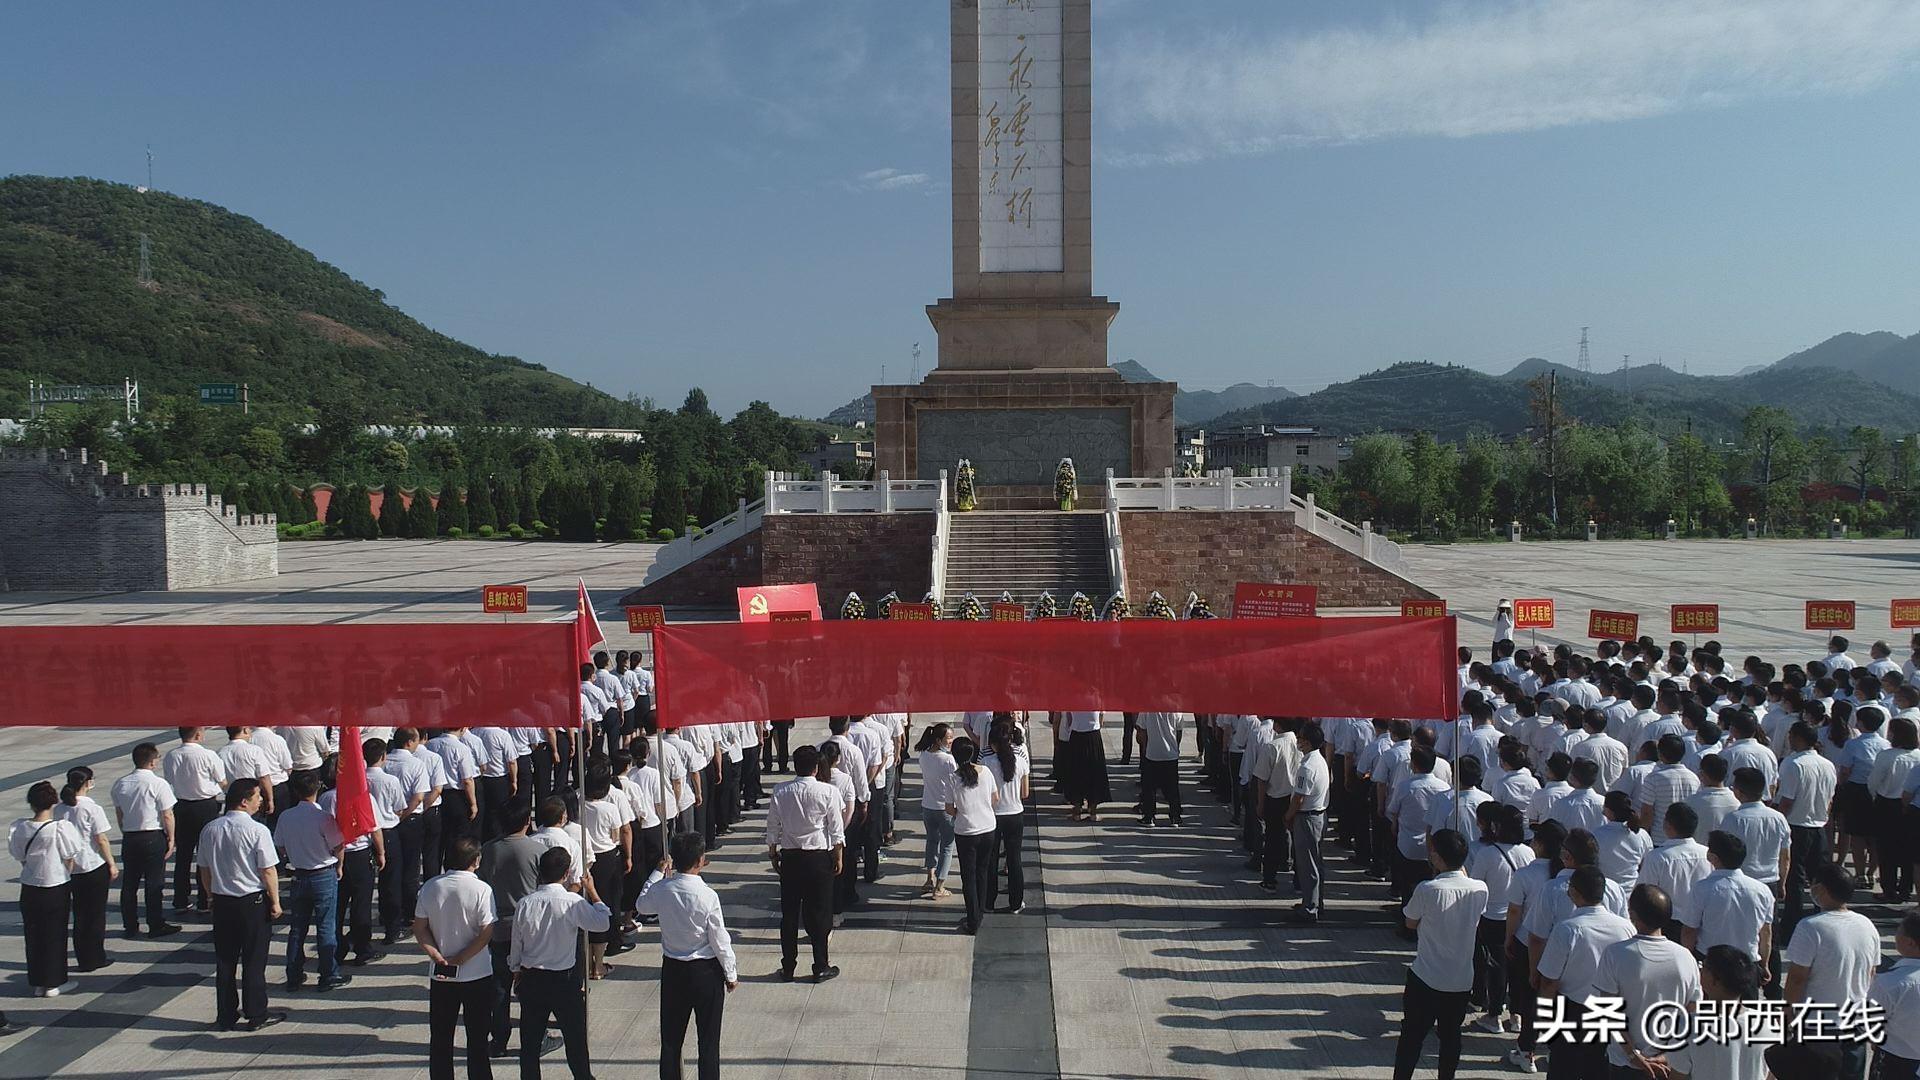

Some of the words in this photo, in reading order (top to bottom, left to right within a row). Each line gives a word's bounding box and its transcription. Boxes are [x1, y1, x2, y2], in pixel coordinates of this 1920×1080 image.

[487, 590, 524, 608] 县邮政公司
[1517, 605, 1552, 622] 县人民医院
[1675, 610, 1716, 627] 县妇保院
[1810, 607, 1852, 623] 县疾控中心
[1592, 616, 1635, 636] 县中医医院
